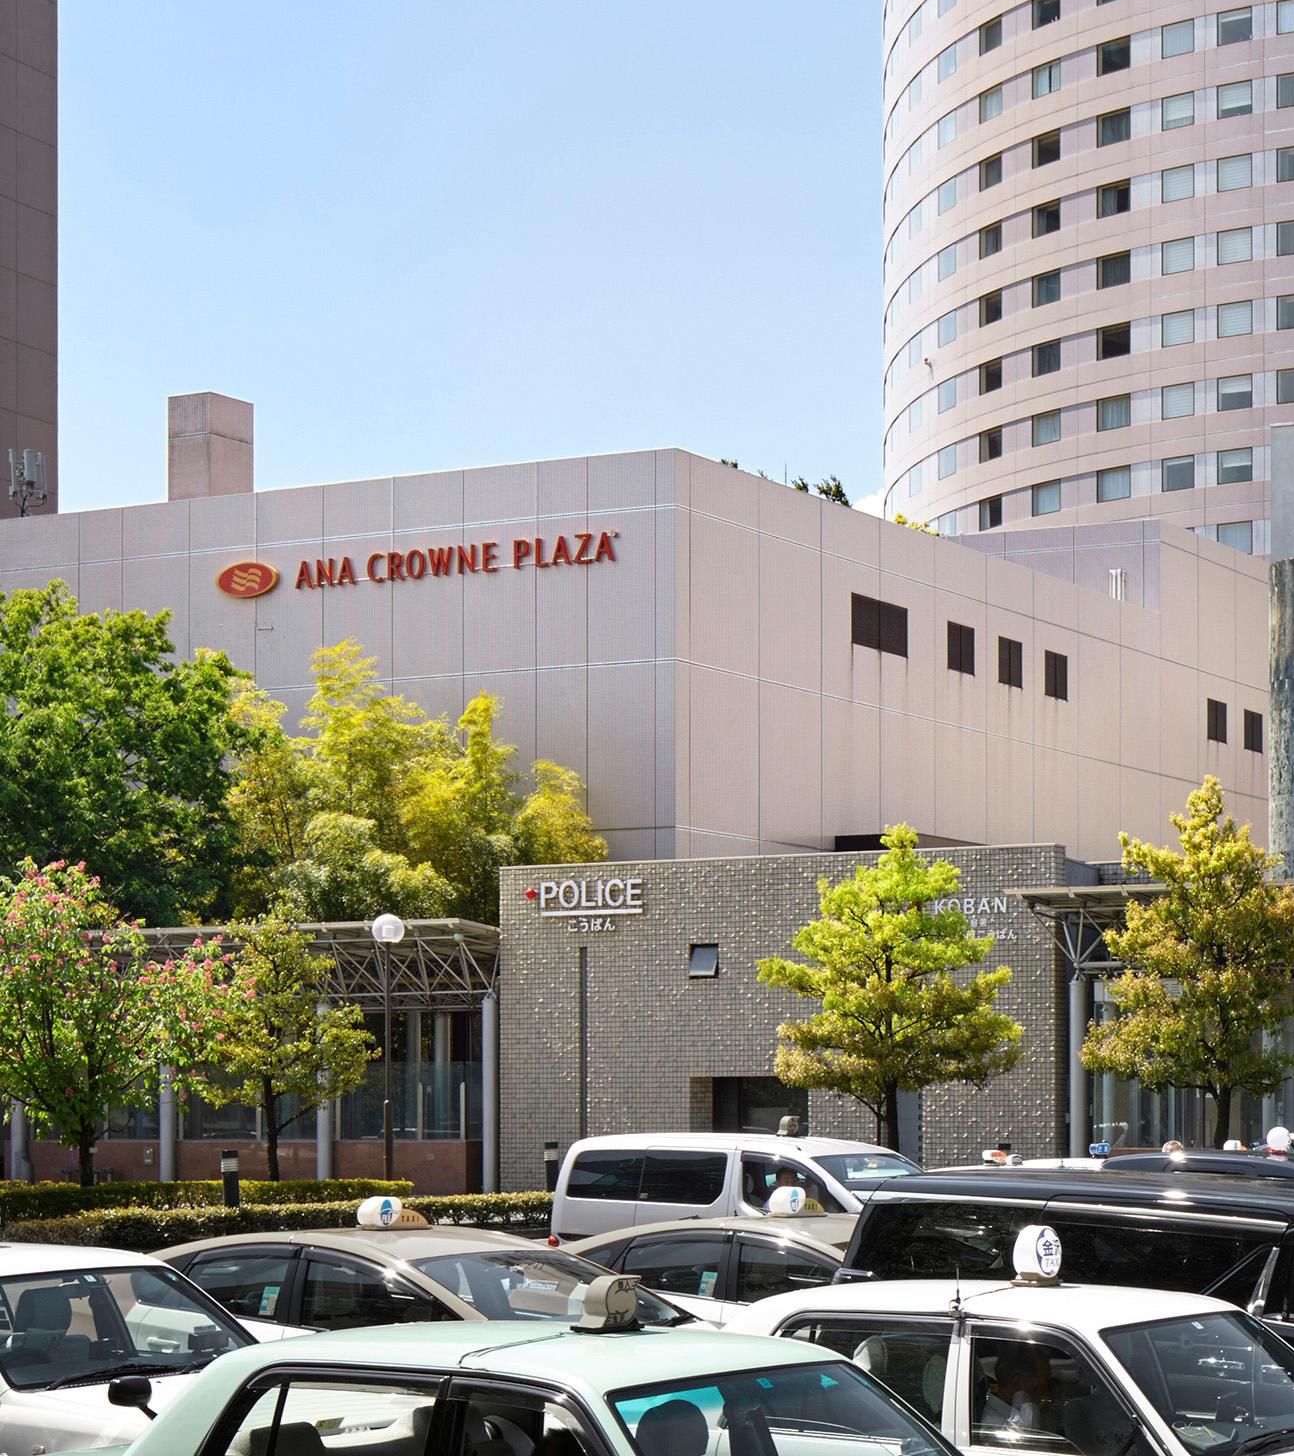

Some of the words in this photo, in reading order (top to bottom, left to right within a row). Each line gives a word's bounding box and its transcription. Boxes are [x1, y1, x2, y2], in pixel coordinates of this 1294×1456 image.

[295, 557, 357, 590] ANA
[367, 542, 499, 584] CROWNE
[513, 531, 616, 569] PLAZA
[540, 879, 643, 908] POLICE
[935, 897, 1007, 915] KOBAN
[567, 917, 615, 932] こうばん
[401, 1215, 420, 1223] TAXI
